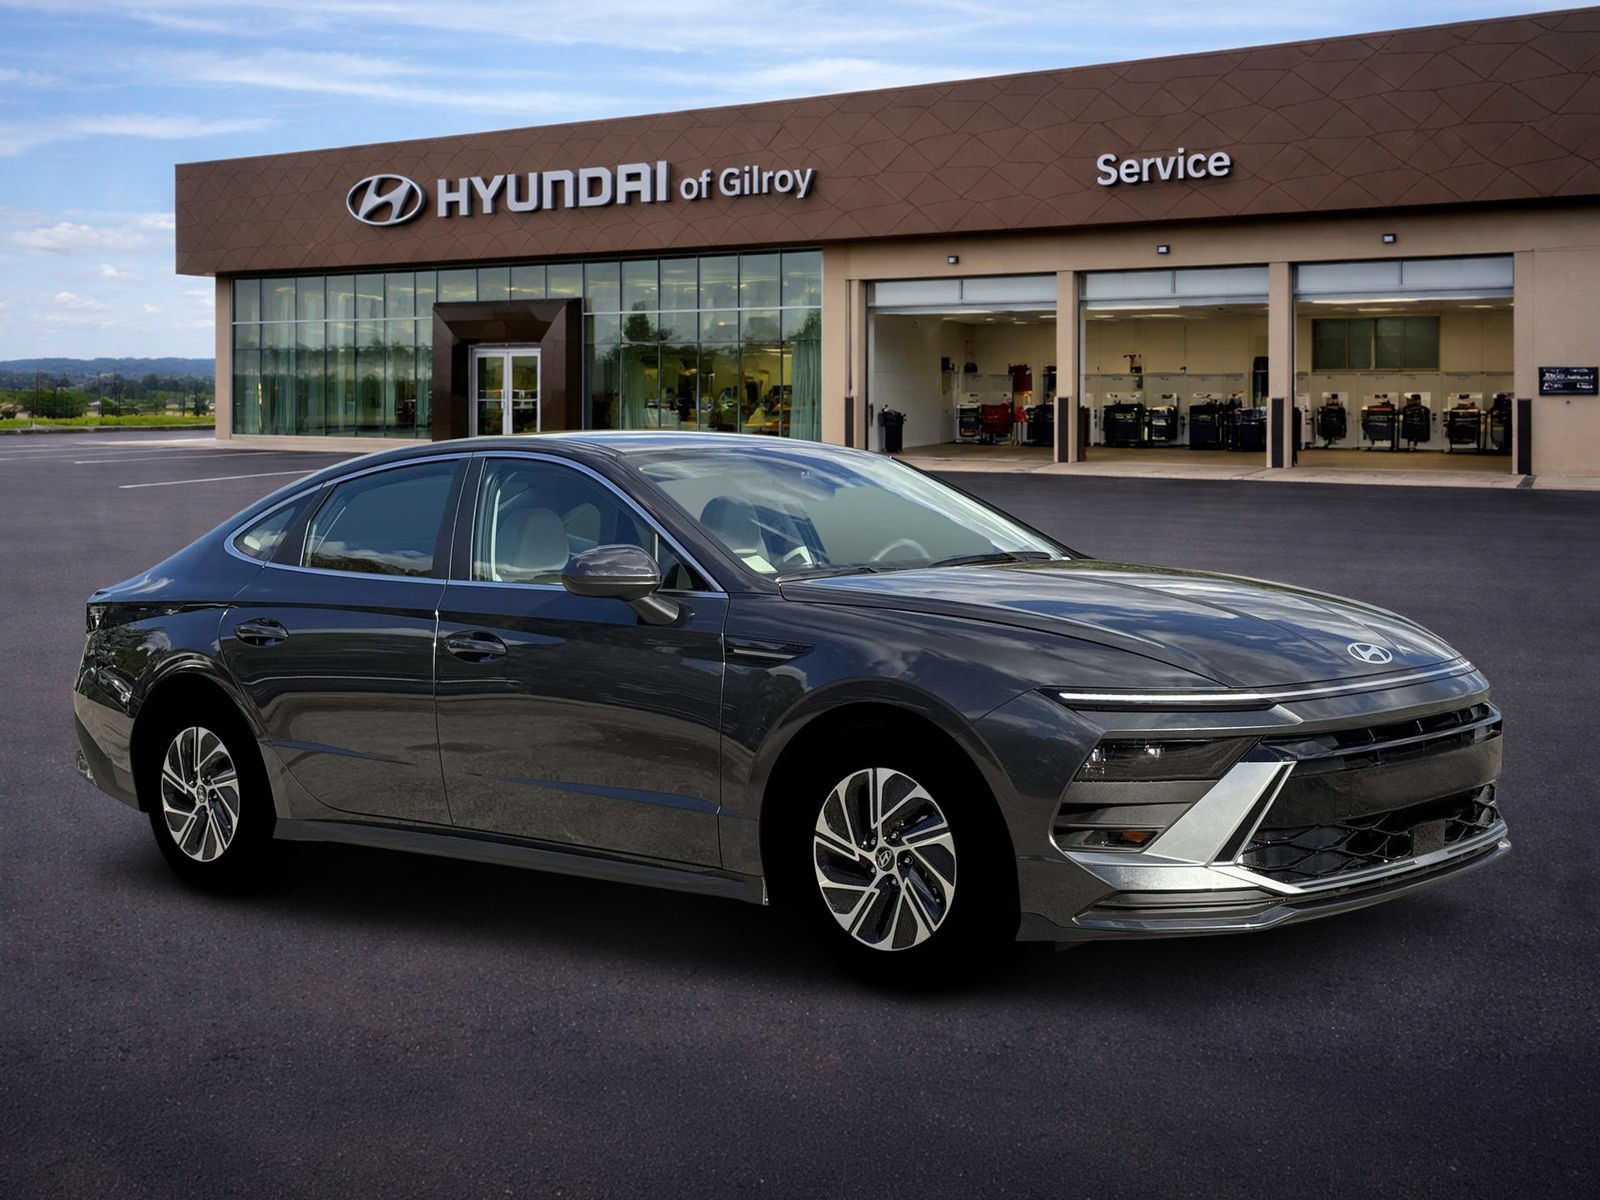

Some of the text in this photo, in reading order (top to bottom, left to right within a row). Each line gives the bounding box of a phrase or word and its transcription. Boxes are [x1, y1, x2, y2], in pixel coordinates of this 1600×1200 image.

[436, 160, 814, 218] HYUNDAI of Gilroy
[1096, 147, 1231, 187] Service
